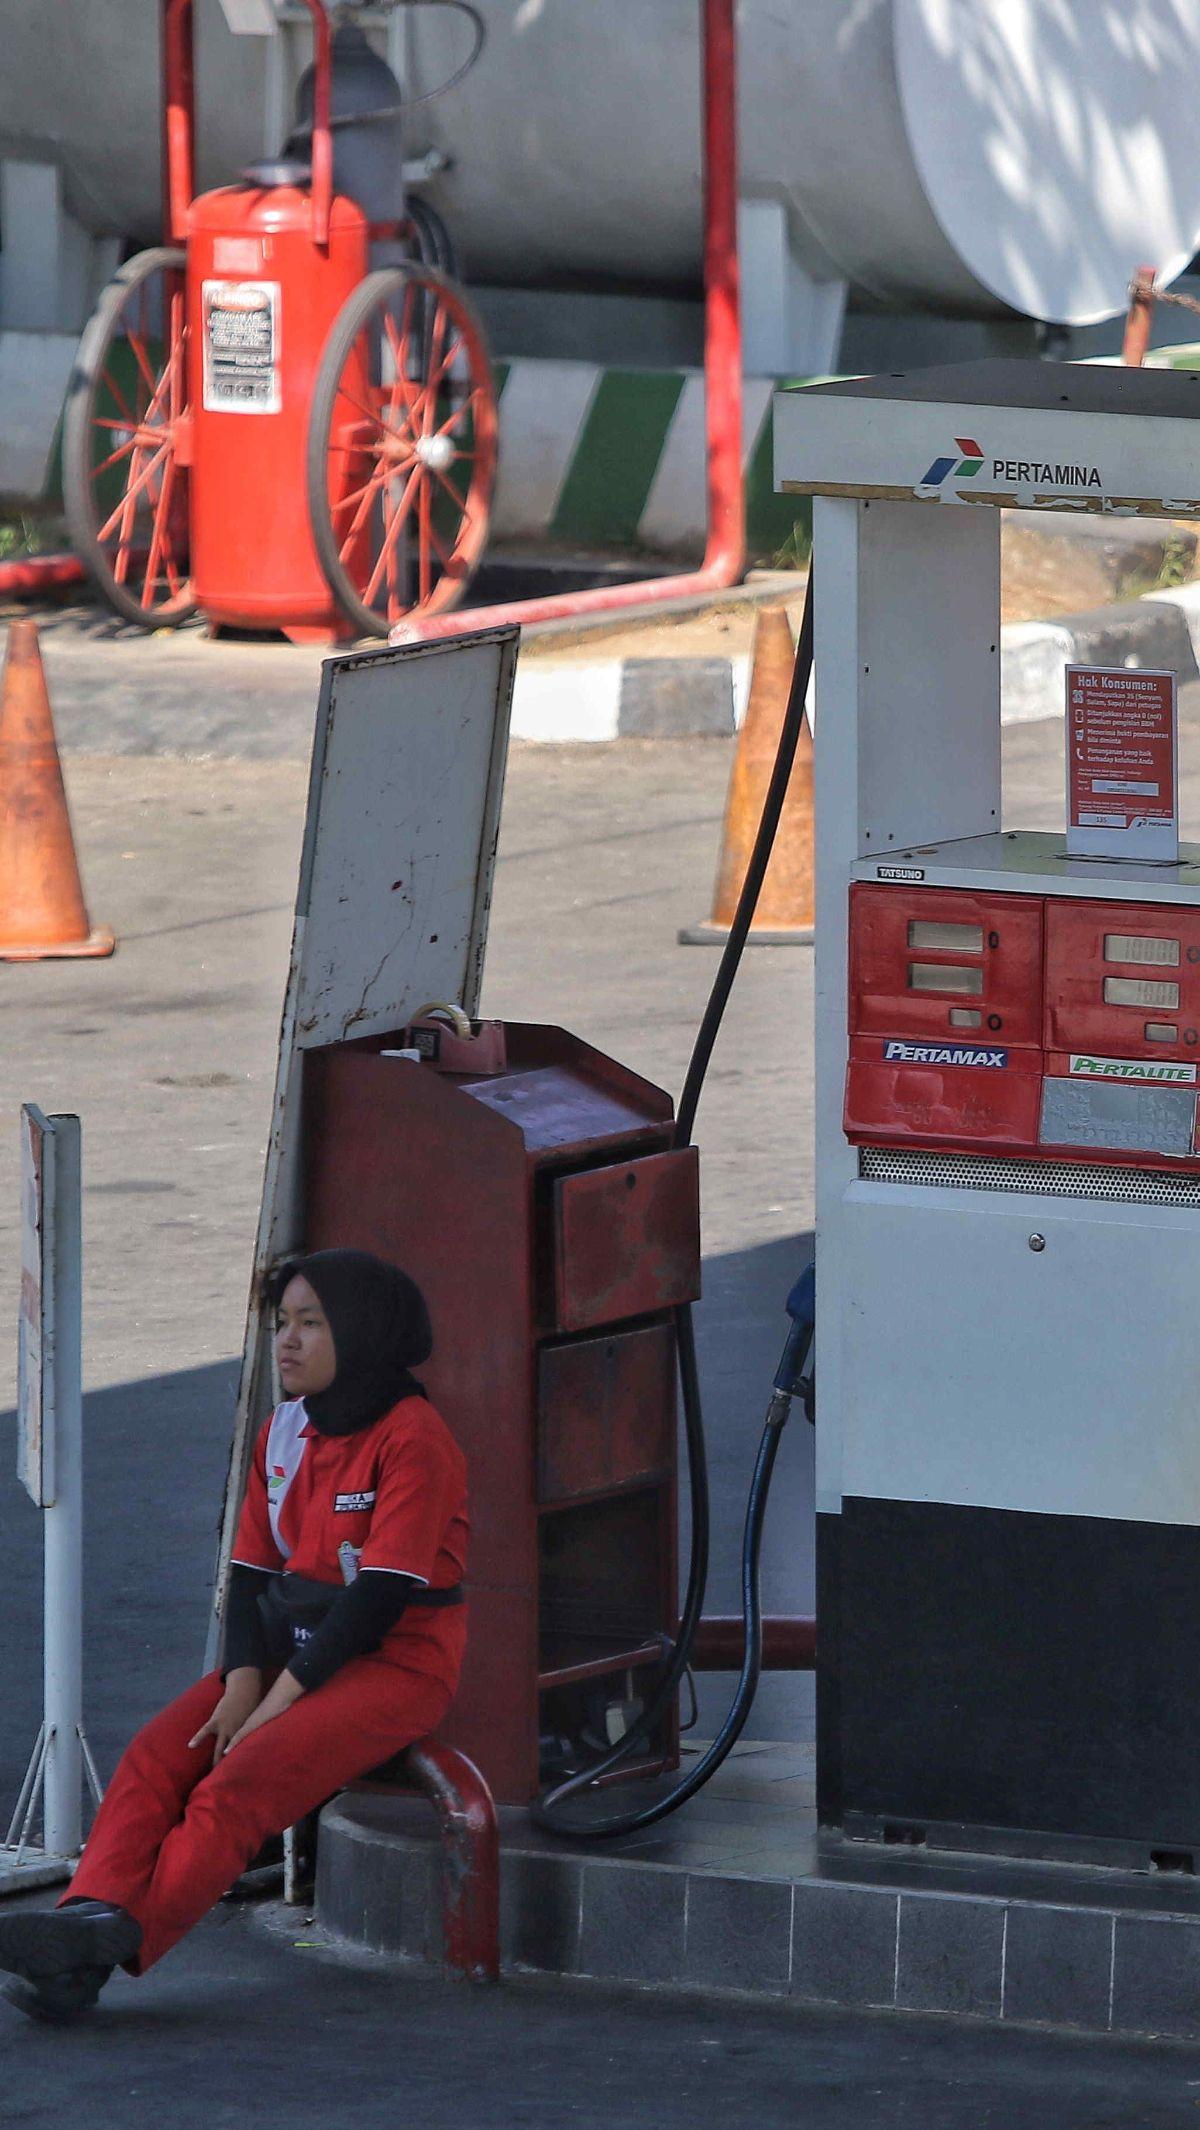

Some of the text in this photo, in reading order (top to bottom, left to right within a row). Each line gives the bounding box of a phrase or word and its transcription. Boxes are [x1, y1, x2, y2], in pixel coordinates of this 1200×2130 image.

[993, 460, 1102, 488] PERTAMINA
[1078, 675, 1157, 691] Hak Konsumen:
[1086, 691, 1126, 700] Mendapatkan
[1138, 702, 1162, 710] petugas
[1123, 712, 1141, 720] angka
[1112, 719, 1140, 727] pengisian
[1133, 731, 1169, 739] pembayaran
[1087, 748, 1123, 756] Penanganan
[879, 868, 922, 880] TATSUNO
[885, 1042, 1005, 1067] PERTAMAX
[1073, 1058, 1193, 1081] PERTALITE
